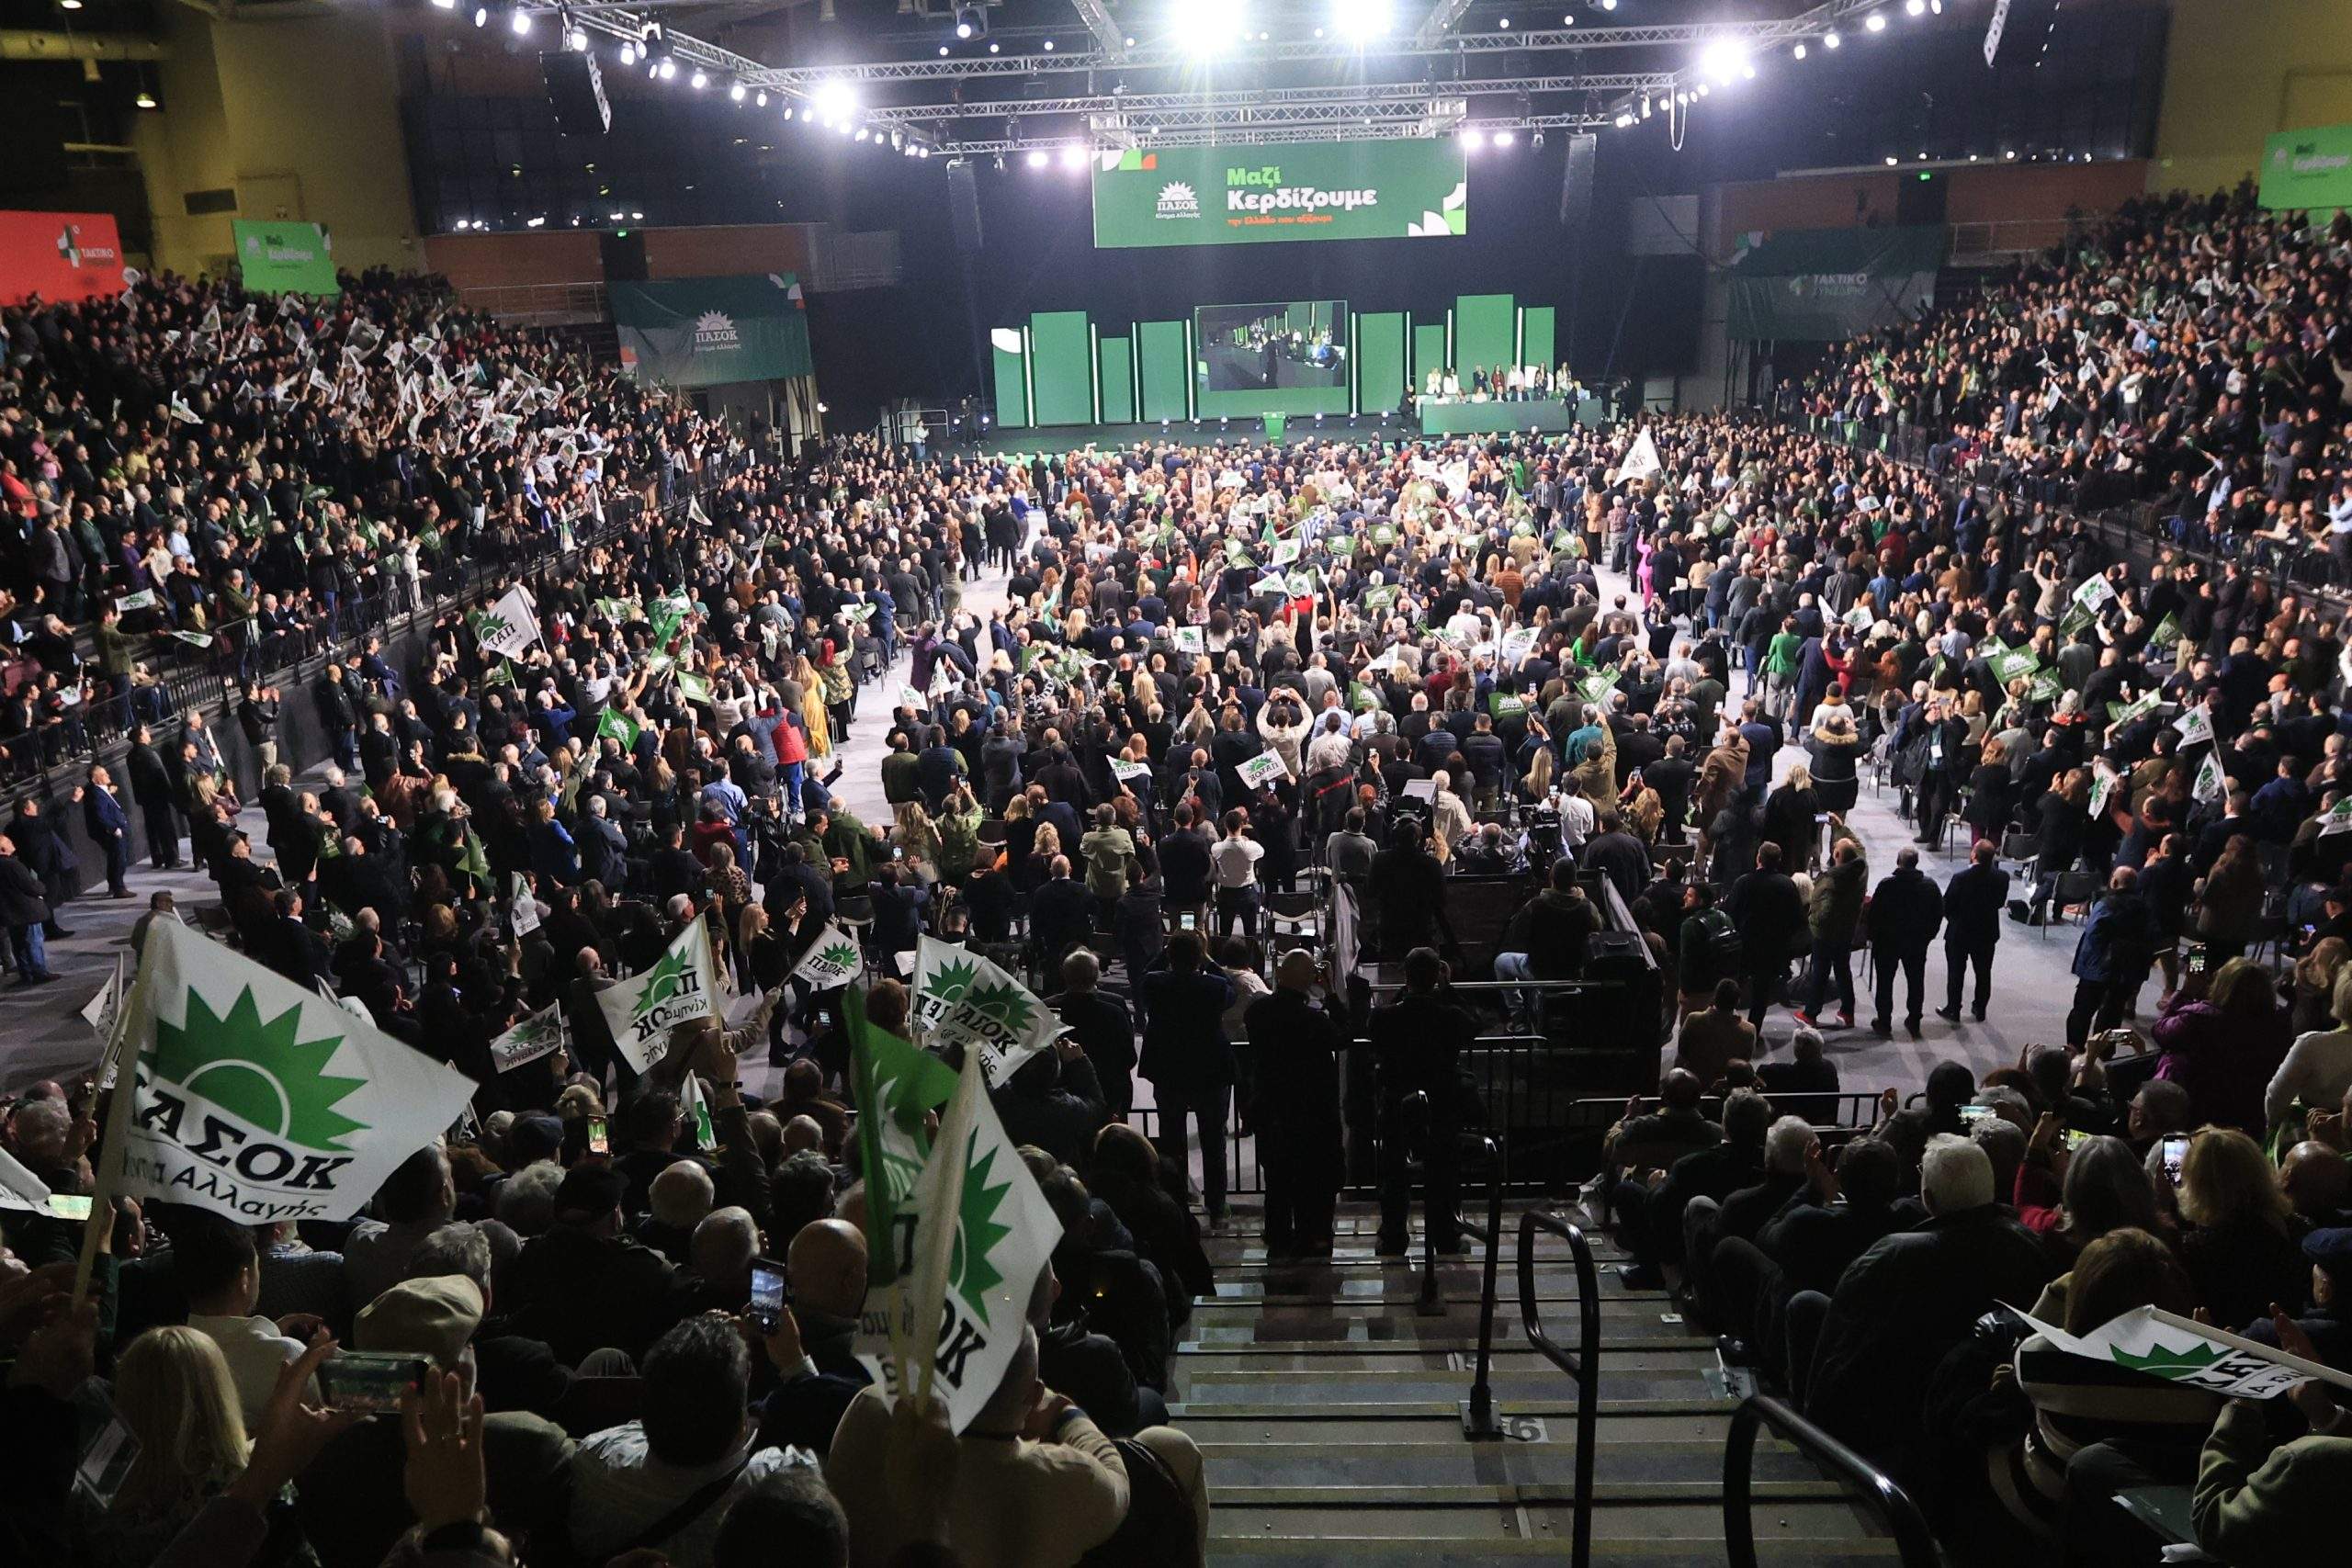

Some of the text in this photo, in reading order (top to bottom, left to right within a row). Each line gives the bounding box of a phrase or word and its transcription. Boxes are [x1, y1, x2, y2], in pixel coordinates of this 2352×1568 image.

[1227, 166, 1282, 188] Μαζί
[1157, 200, 1199, 211] ΠΑΣΟΚ
[1227, 187, 1377, 214] Κερδίζουμε
[1814, 274, 1867, 285] ΤΑΚΤΙΚΟ
[695, 330, 739, 343] ΠΑΣΟΚ
[171, 1166, 328, 1220] Αλλαγής
